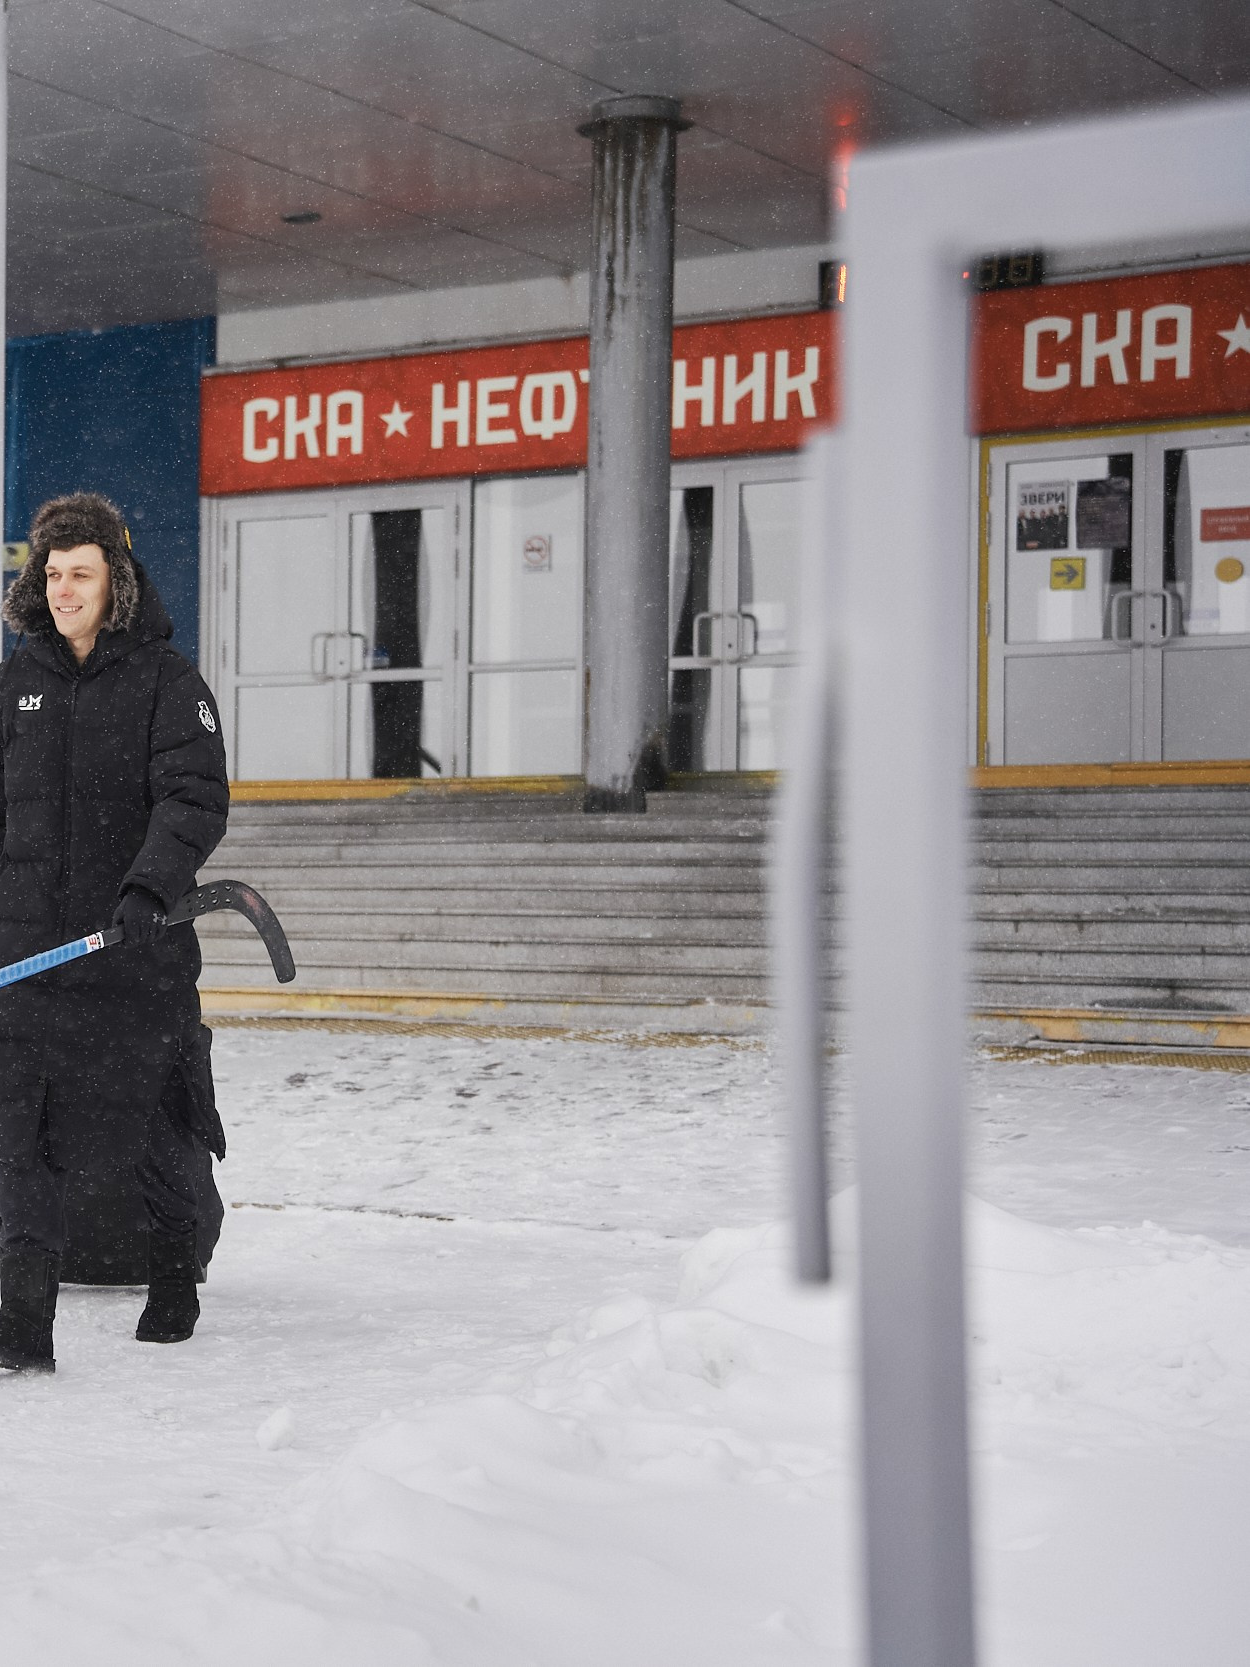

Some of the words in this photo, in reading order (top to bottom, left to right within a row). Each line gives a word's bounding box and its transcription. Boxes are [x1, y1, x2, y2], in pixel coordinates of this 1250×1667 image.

[1022, 304, 1192, 392] СКА
[243, 390, 363, 463] СКА
[431, 346, 819, 450] НЕФНИК
[1020, 491, 1065, 506] ЗВЕРИ
